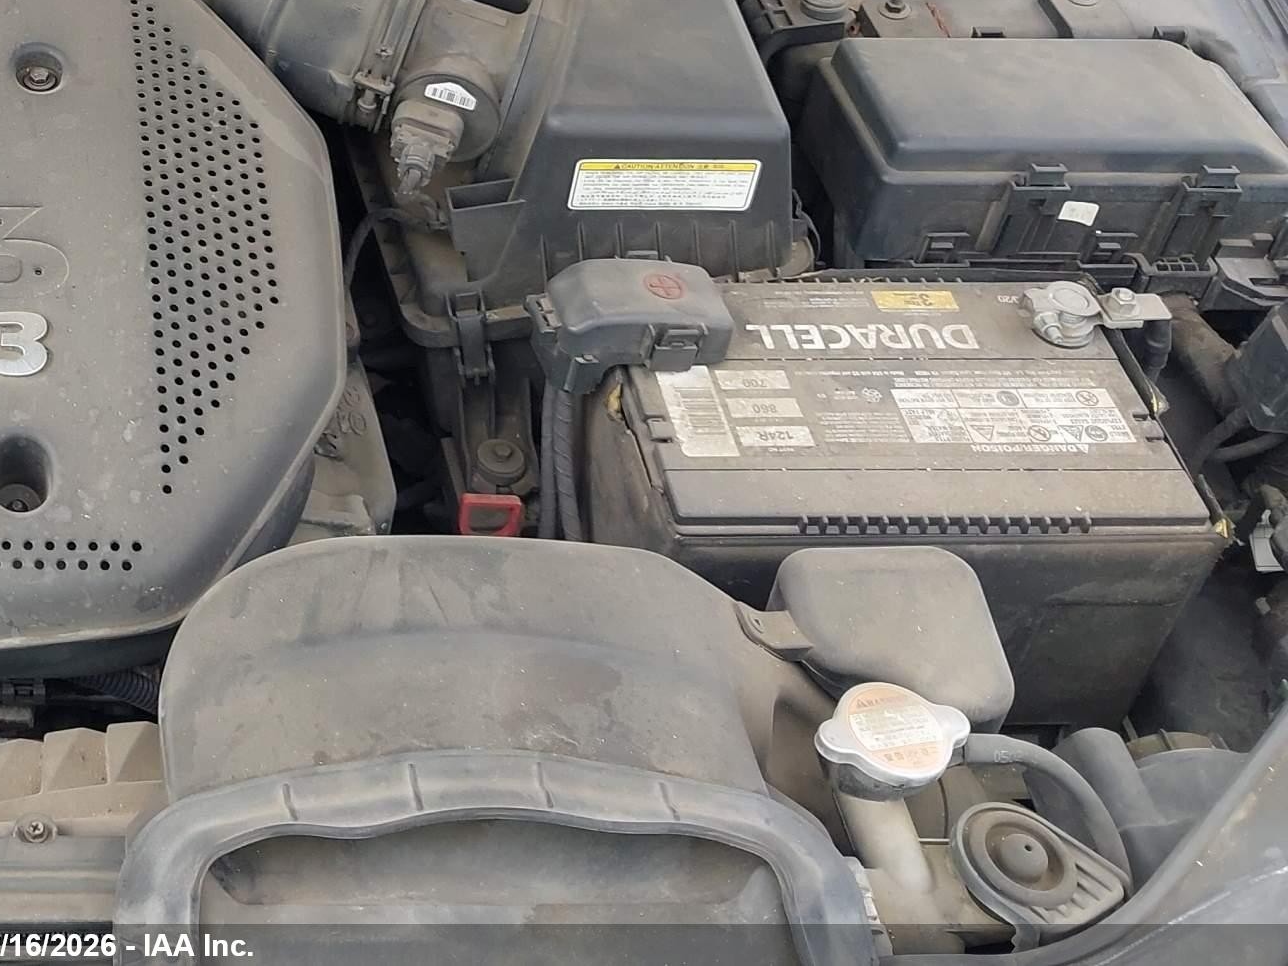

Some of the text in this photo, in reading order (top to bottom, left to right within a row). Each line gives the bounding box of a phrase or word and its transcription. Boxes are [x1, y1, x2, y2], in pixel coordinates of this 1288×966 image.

[745, 323, 981, 350] DURACELL
[741, 378, 769, 388] 700
[752, 403, 777, 413] 860
[757, 431, 794, 441] 124R
